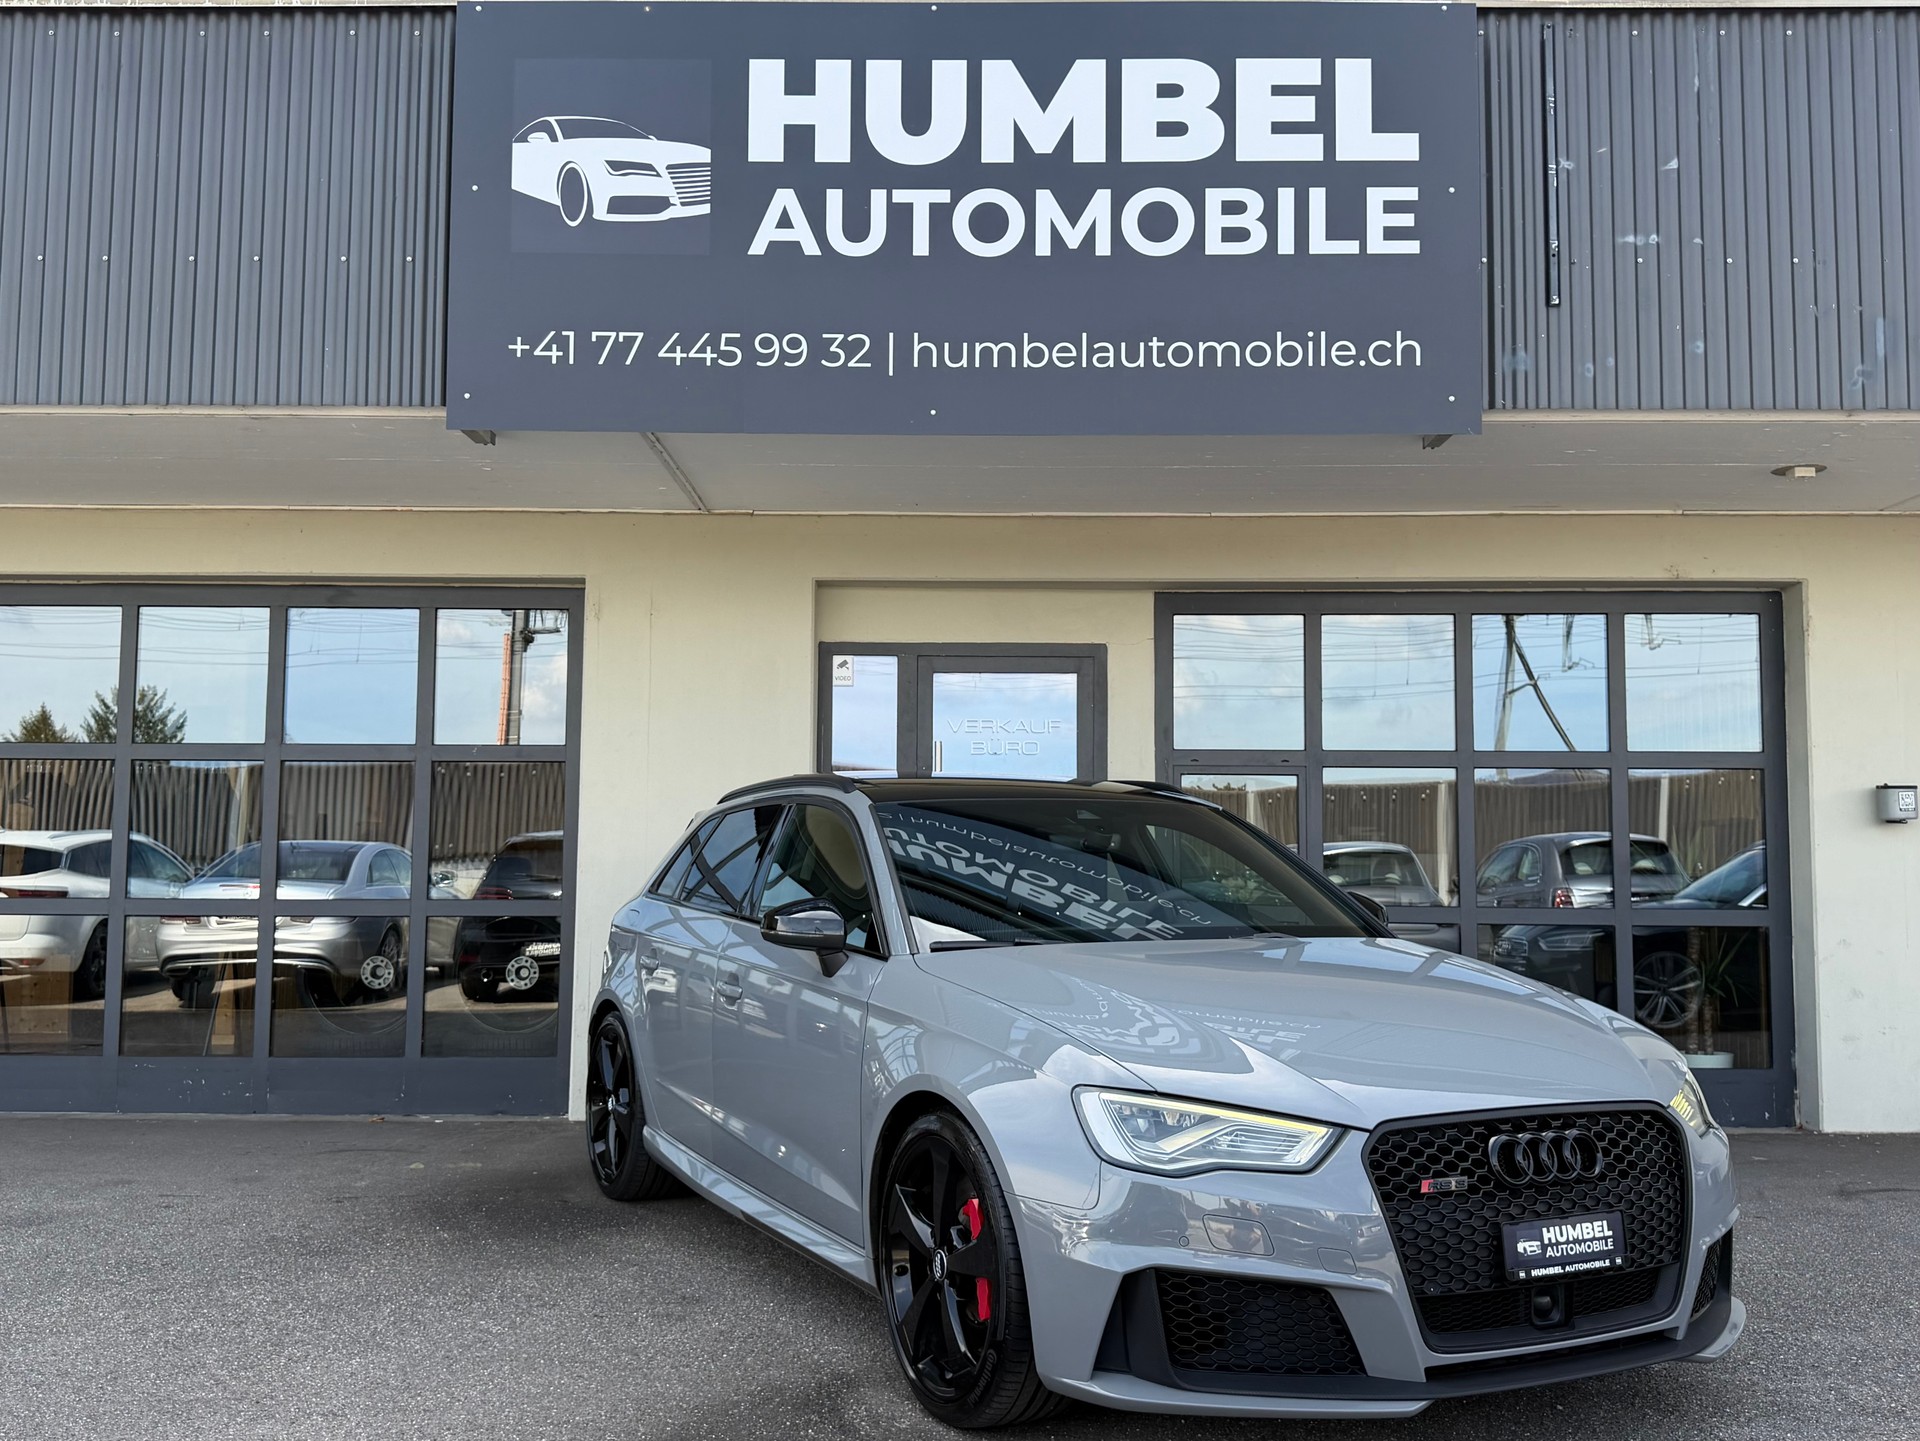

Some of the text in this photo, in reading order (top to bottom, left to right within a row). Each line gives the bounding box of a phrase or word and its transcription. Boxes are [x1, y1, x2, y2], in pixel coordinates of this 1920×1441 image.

[747, 57, 1420, 165] HUMBEL
[746, 186, 1421, 258] AUTOMOBILE
[507, 330, 575, 365] +41
[591, 331, 645, 366] 77
[657, 332, 743, 367] 445
[754, 332, 808, 367] 99
[820, 333, 872, 368] 32
[913, 330, 1421, 369] humbelautomobile.ch
[947, 719, 1062, 734] VERKAUF
[970, 738, 1040, 755] BÜRO
[1541, 1220, 1613, 1245] HUMBEL
[1546, 1238, 1614, 1258] AUTOMOBILE
[1531, 1258, 1611, 1277] HUMBEL AUTOMOBILE
